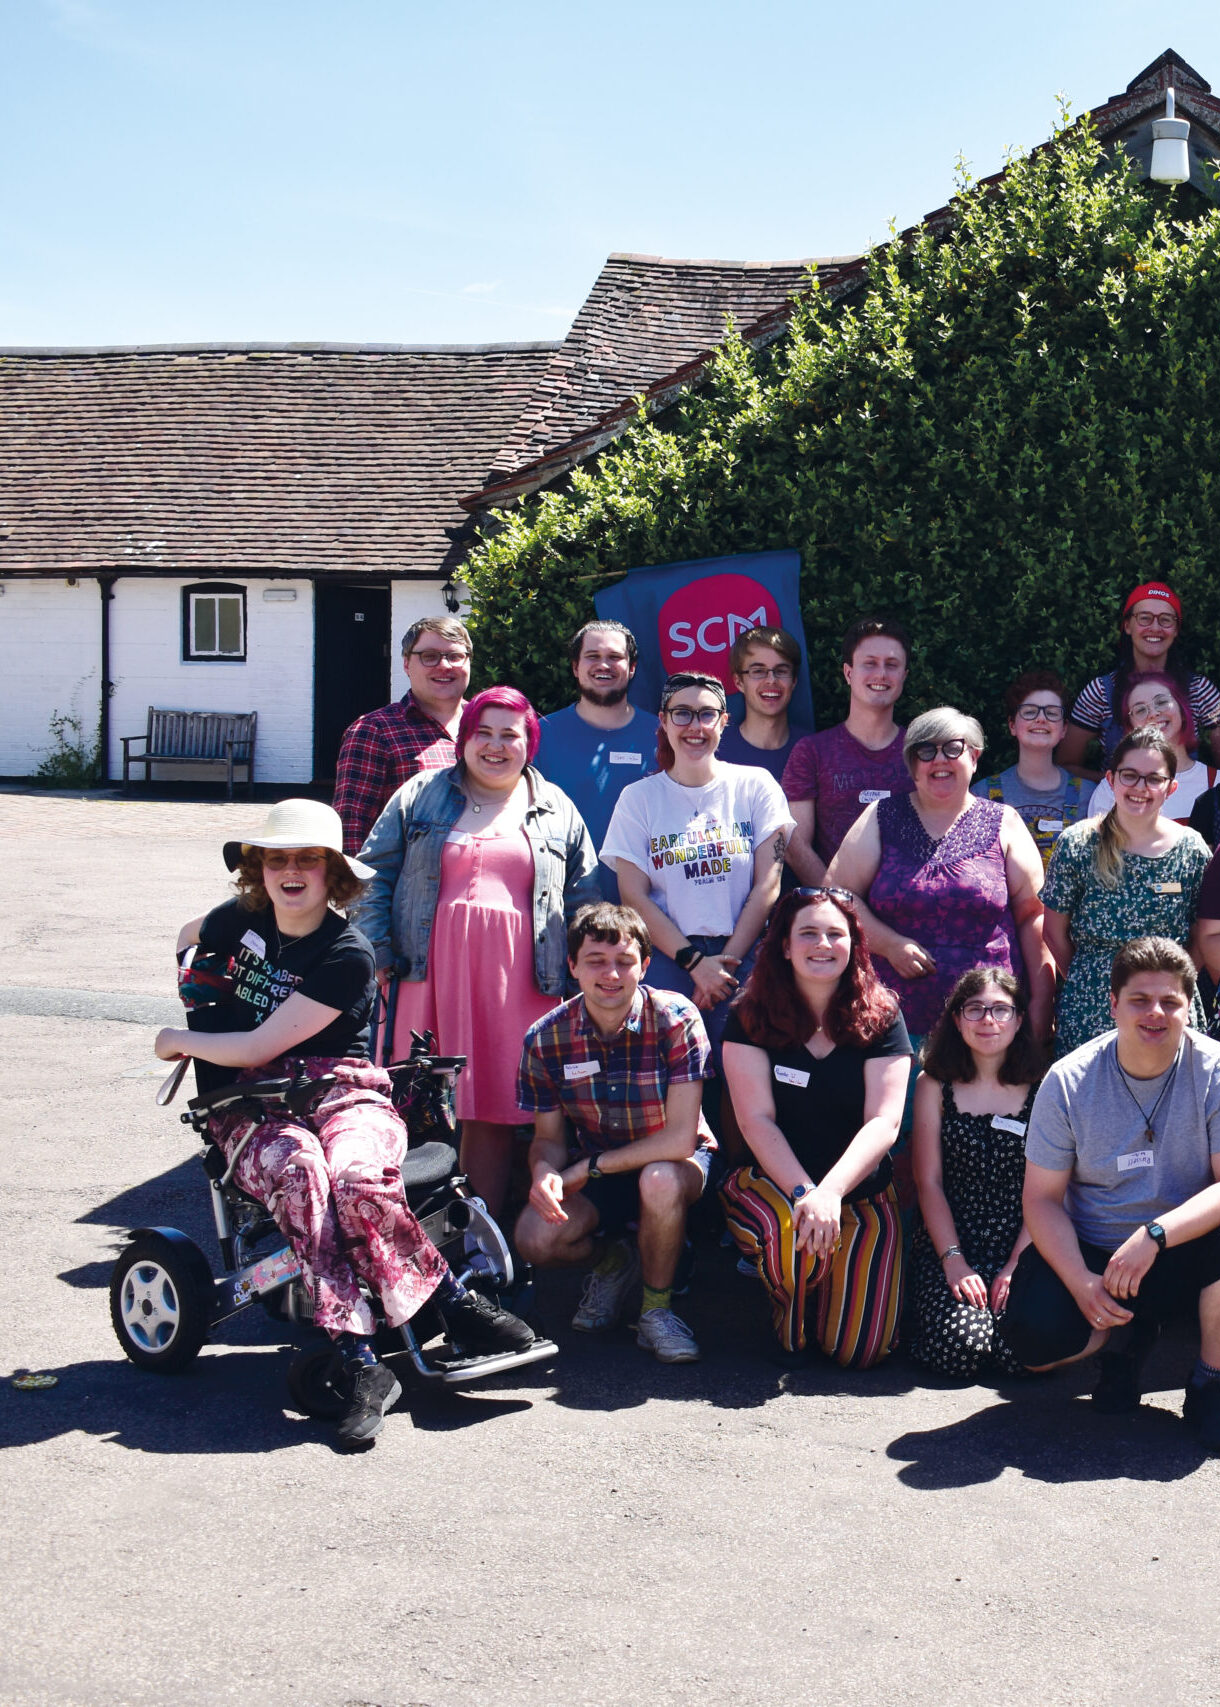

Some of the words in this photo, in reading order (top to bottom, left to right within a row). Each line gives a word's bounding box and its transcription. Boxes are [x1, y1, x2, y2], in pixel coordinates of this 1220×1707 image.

[650, 826, 722, 853] EARFULLY
[732, 821, 753, 838] AN
[684, 858, 732, 879] MADE
[239, 946, 260, 966] IT'S
[235, 983, 269, 1008] ABLED
